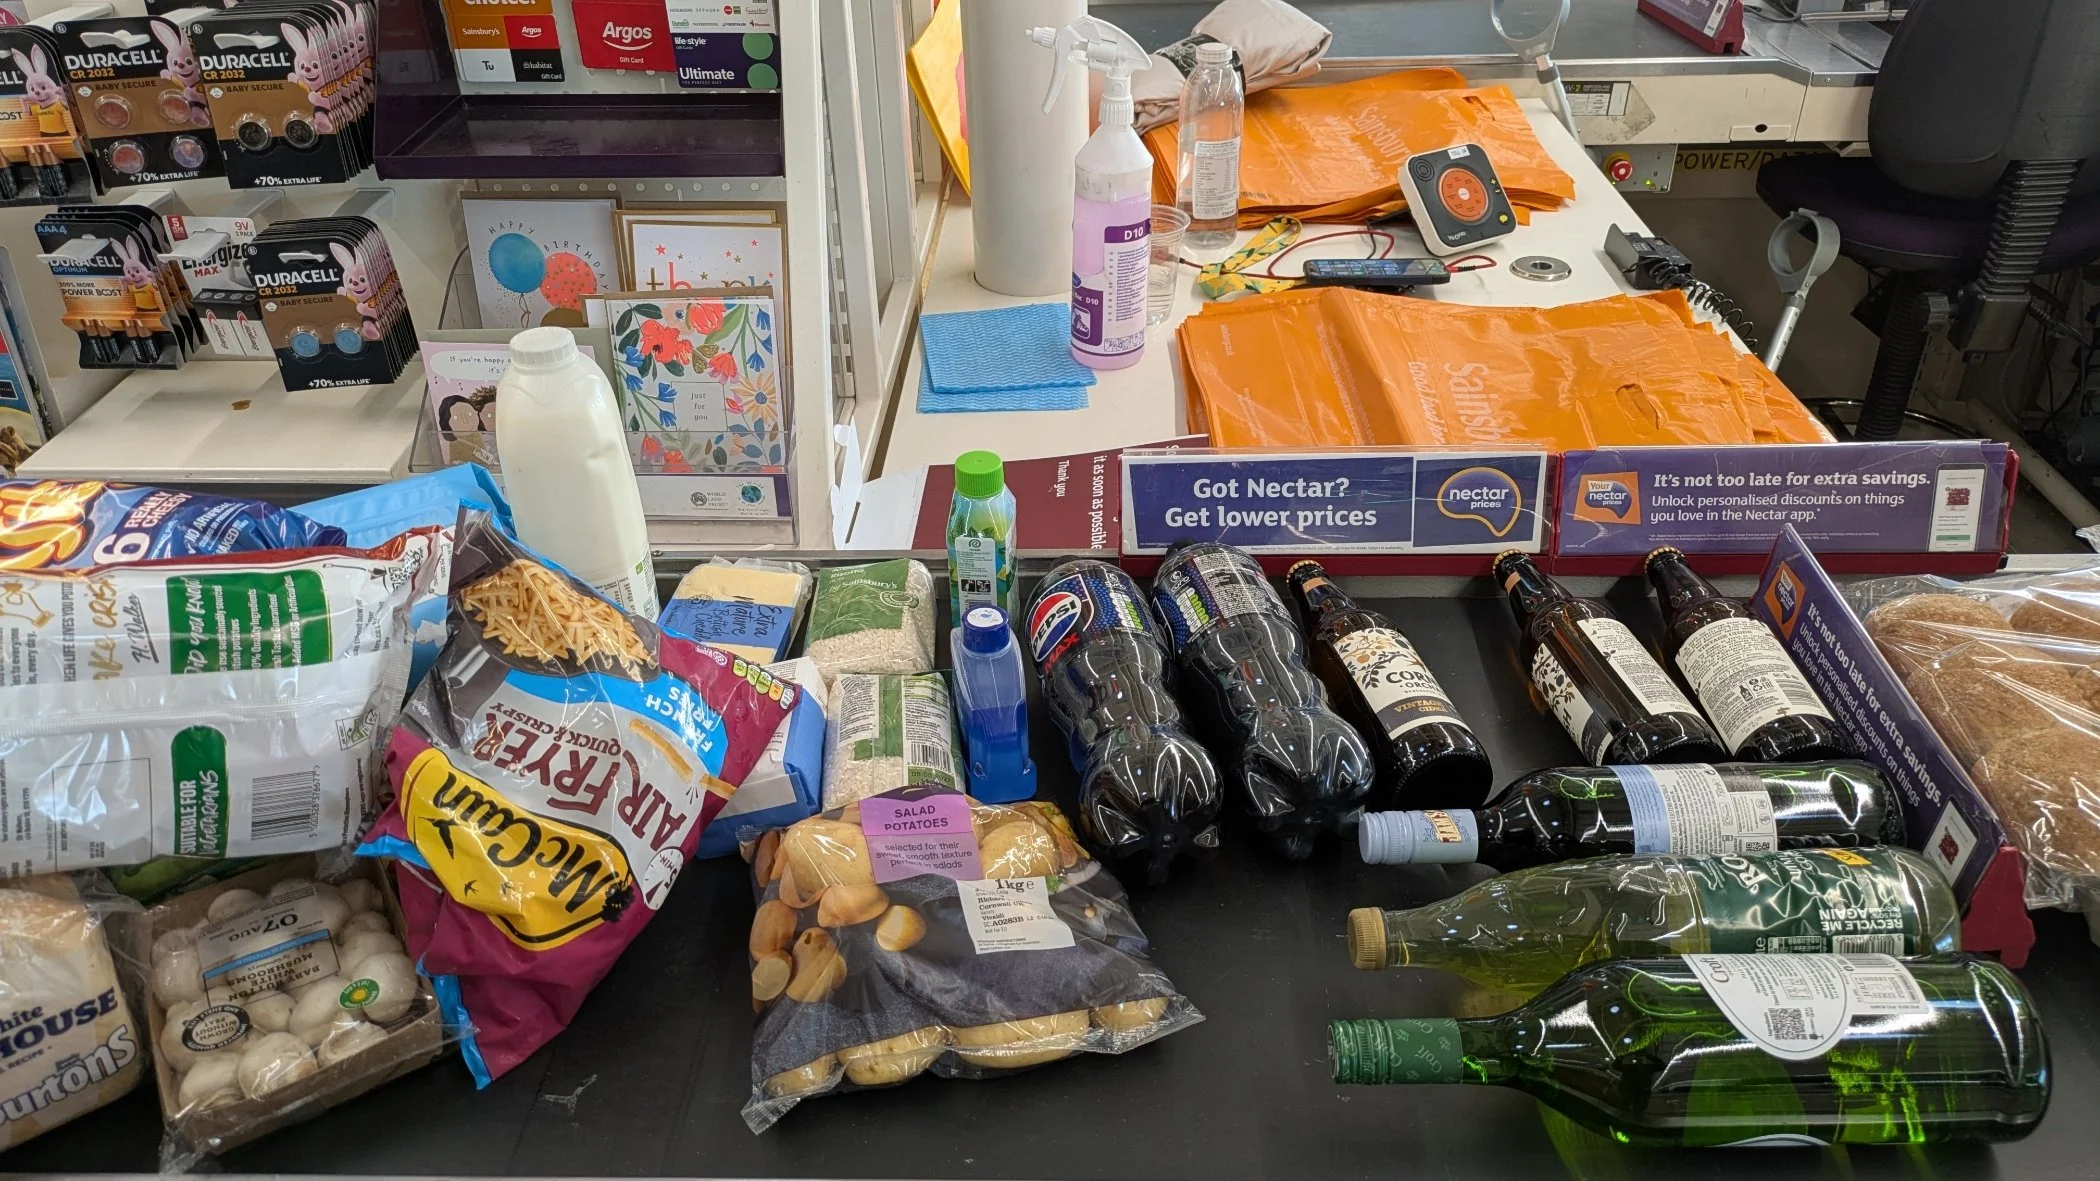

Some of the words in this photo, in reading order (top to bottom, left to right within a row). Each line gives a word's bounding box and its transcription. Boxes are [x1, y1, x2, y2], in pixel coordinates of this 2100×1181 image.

[462, 28, 500, 37] Sainsbury's
[522, 26, 542, 34] Argos
[602, 22, 652, 43] Argos
[64, 50, 162, 70] DURACELL
[199, 52, 291, 70] DURACELL
[482, 60, 494, 70] Tu
[70, 71, 86, 79] CR
[88, 68, 115, 78] 2032
[203, 71, 219, 80] CR
[220, 69, 245, 79] 2032
[680, 68, 735, 80] Ultimate
[95, 82, 119, 91] BABY
[122, 80, 157, 89] SECURE
[226, 85, 249, 93] BABY
[252, 83, 284, 92] SECURE
[129, 172, 159, 182] +70%
[254, 176, 283, 186] +70%
[37, 225, 59, 233] AAA
[235, 222, 249, 231] 9V
[489, 220, 536, 236] HAPPY
[1124, 227, 1144, 240] D10
[181, 242, 251, 270] Energize
[194, 266, 219, 277] MAX
[543, 241, 609, 290] BIRTHDAY
[254, 269, 339, 287] DURACELL
[259, 288, 272, 296] CR
[275, 286, 297, 294] 2032
[304, 297, 334, 305] SECURE
[1086, 297, 1099, 306] D10
[460, 356, 481, 364] you're
[309, 379, 334, 388] +70%
[1093, 456, 1107, 464] it
[1058, 460, 1070, 483] Thank
[1094, 465, 1104, 474] as
[1093, 475, 1104, 497] soon
[1193, 478, 1239, 498] Got
[1247, 477, 1350, 498] Nectar?
[1590, 482, 1611, 490] Your
[1653, 474, 1680, 487] It's
[1684, 474, 1712, 487] not
[1717, 474, 1745, 487] too
[1749, 472, 1782, 486] late
[1786, 471, 1810, 486] for
[1814, 472, 1858, 486] extra
[1862, 471, 1931, 488] savings.
[1056, 484, 1066, 497] you
[1449, 487, 1509, 500] nectar
[1589, 491, 1627, 500] nectar
[1092, 499, 1103, 509] as
[1470, 500, 1501, 510] prices
[1652, 495, 1695, 507] Unlock
[1697, 494, 1778, 509] personalised
[1780, 492, 1842, 505] discounts
[1845, 495, 1861, 505] on
[1864, 492, 1905, 508] things
[124, 491, 169, 528] REALLY
[142, 492, 193, 528] CHEESY
[1651, 511, 1675, 524] you
[1677, 509, 1703, 521] love
[1706, 509, 1718, 520] in
[1721, 508, 1742, 521] the
[1745, 508, 1786, 521] Nectar
[1165, 506, 1210, 527] Get
[1218, 506, 1290, 527] lower
[1297, 506, 1377, 532] prices
[1088, 510, 1107, 550] possible
[93, 532, 149, 565] 6
[1777, 583, 1795, 608] nectar
[726, 596, 755, 637] Mature
[754, 604, 782, 638] Extra
[231, 619, 242, 650] potatoes
[1044, 632, 1080, 675] MAX
[1791, 637, 1807, 658] you
[1805, 652, 1817, 677] love
[1816, 671, 1825, 686] in
[1822, 683, 1835, 702] the
[1833, 699, 1856, 732] Nectar
[1807, 601, 1821, 627] It's
[1820, 623, 1837, 649] not
[1835, 641, 1849, 668] too
[1848, 658, 1868, 693] late
[1866, 687, 1881, 713] for
[1879, 710, 1904, 750] extra
[1903, 746, 1942, 808] savings.
[489, 702, 554, 736] CRISPY
[1799, 622, 1820, 657] Unlock
[1817, 652, 1856, 712] personalised
[1856, 707, 1889, 758] discounts
[1887, 756, 1898, 774] on
[1897, 770, 1920, 807] things
[554, 724, 568, 742] &
[566, 733, 622, 756] QUICK
[473, 713, 621, 816] FRYER
[180, 780, 196, 804] FOR
[618, 750, 687, 851] AIR
[894, 805, 936, 818] SALAD
[180, 806, 197, 854] SUITABLE
[885, 817, 949, 831] POTATOES
[436, 769, 620, 915] McCain
[885, 843, 923, 851] selected
[925, 842, 937, 850] for
[940, 842, 960, 850] their
[906, 852, 939, 861] smooth
[941, 850, 972, 859] texture
[933, 860, 963, 870] salads
[665, 868, 677, 889] 5
[994, 878, 1025, 893] 1kg
[1819, 907, 1868, 919] AGAIN
[263, 913, 298, 934] 07
[1821, 920, 1843, 931] ME
[1845, 919, 1903, 931] RECYCLE
[228, 926, 261, 943] AUG
[227, 952, 313, 987] MUSHROOMS
[250, 968, 296, 986] WHITE
[289, 964, 321, 980] BABY
[1700, 957, 1730, 984] Croft
[228, 979, 283, 1002] BUTTON
[0, 1006, 43, 1033] hite
[194, 1019, 237, 1036] WITHOUT
[203, 1016, 226, 1027] PEAT
[200, 1026, 235, 1042] GROWN
[1414, 1045, 1442, 1073] Croft
